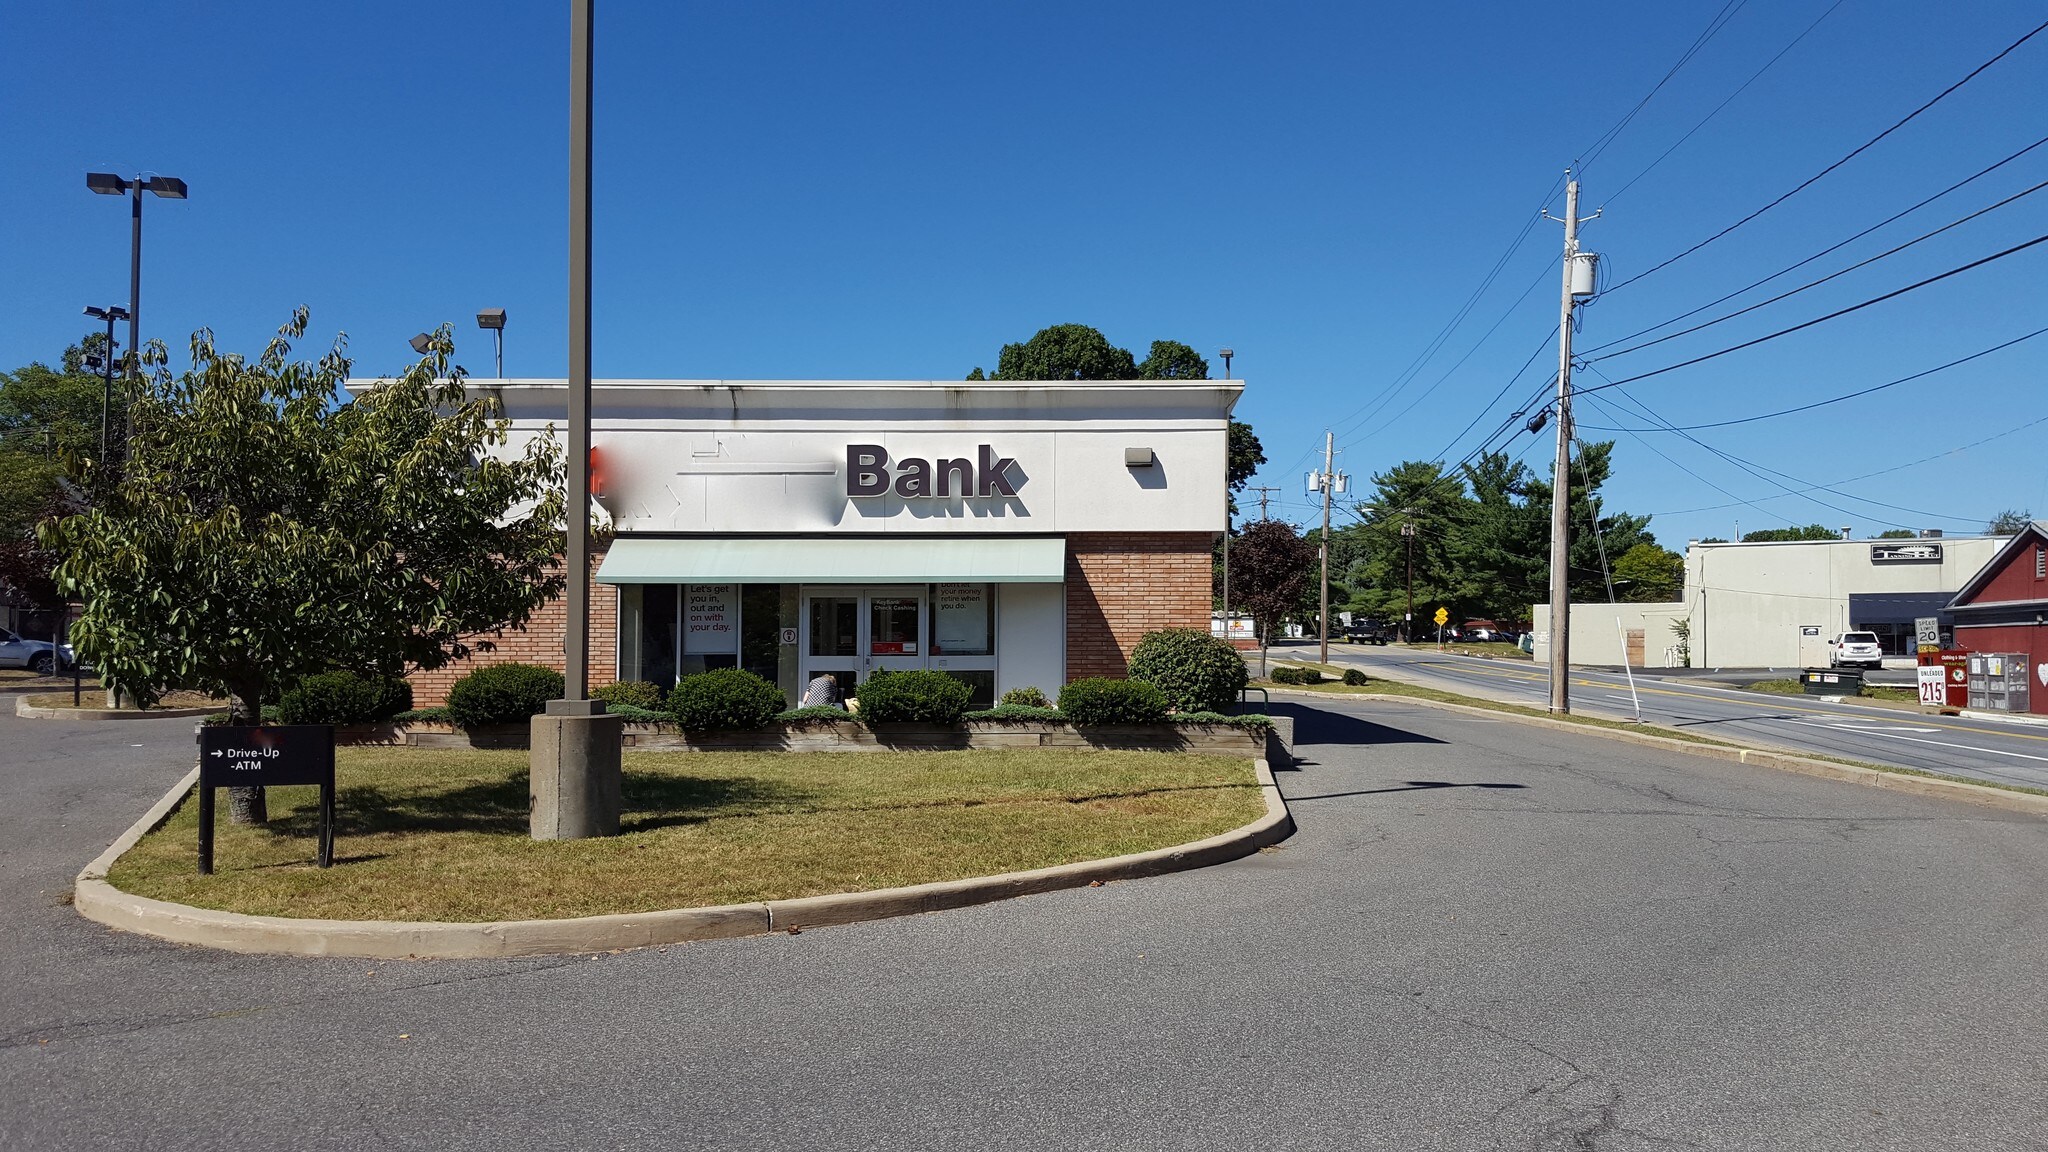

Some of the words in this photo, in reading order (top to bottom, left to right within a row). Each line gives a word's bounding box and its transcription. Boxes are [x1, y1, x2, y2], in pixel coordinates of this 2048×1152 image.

[847, 444, 1017, 498] Bank
[690, 585, 711, 593] Let's
[714, 586, 729, 594] get
[690, 595, 706, 604] you
[709, 594, 720, 603] in,
[704, 613, 724, 621] with
[690, 624, 710, 632] your
[712, 623, 731, 632] day.
[1919, 631, 1937, 641] 20
[1921, 682, 1942, 701] 215
[227, 748, 280, 759] Drive-Up
[230, 761, 262, 770] -ATM
